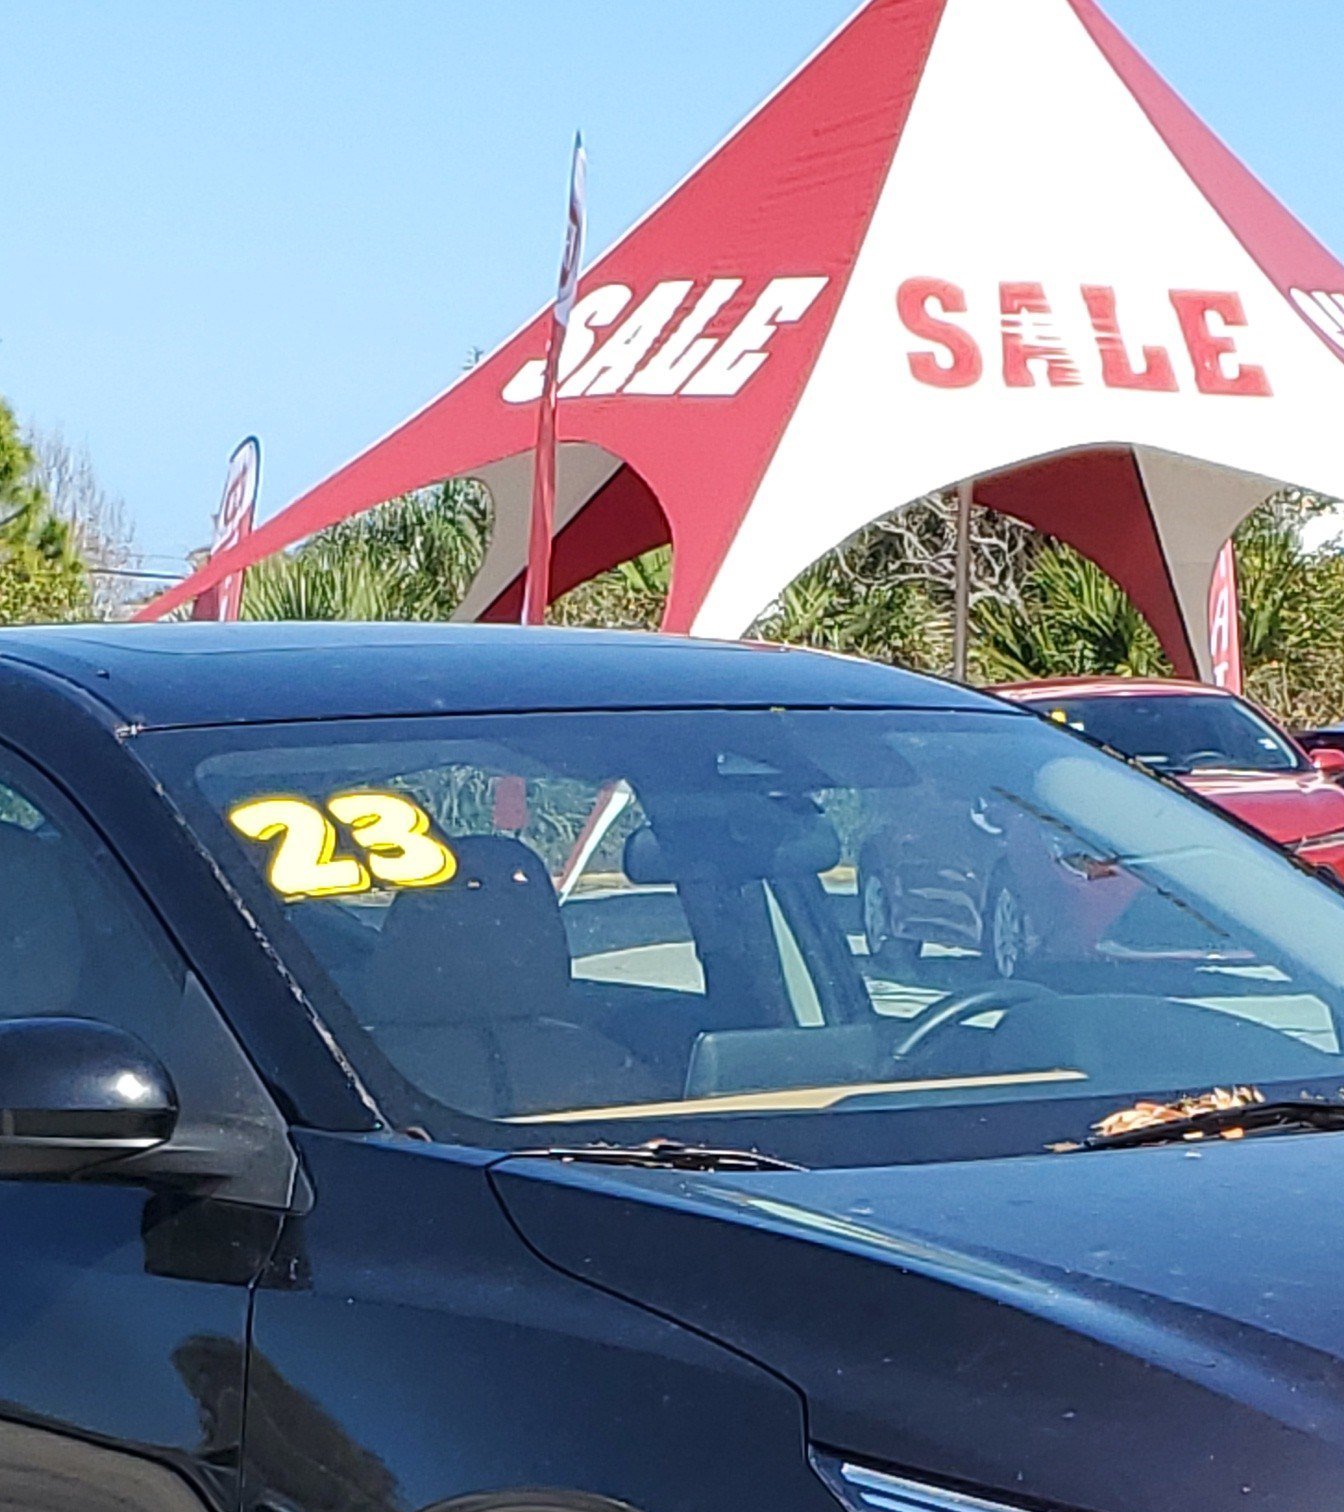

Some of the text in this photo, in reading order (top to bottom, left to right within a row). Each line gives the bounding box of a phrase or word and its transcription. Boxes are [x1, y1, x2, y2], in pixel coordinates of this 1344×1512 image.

[501, 277, 829, 404] SALE
[896, 276, 1275, 397] SALE
[229, 792, 457, 896] 23
